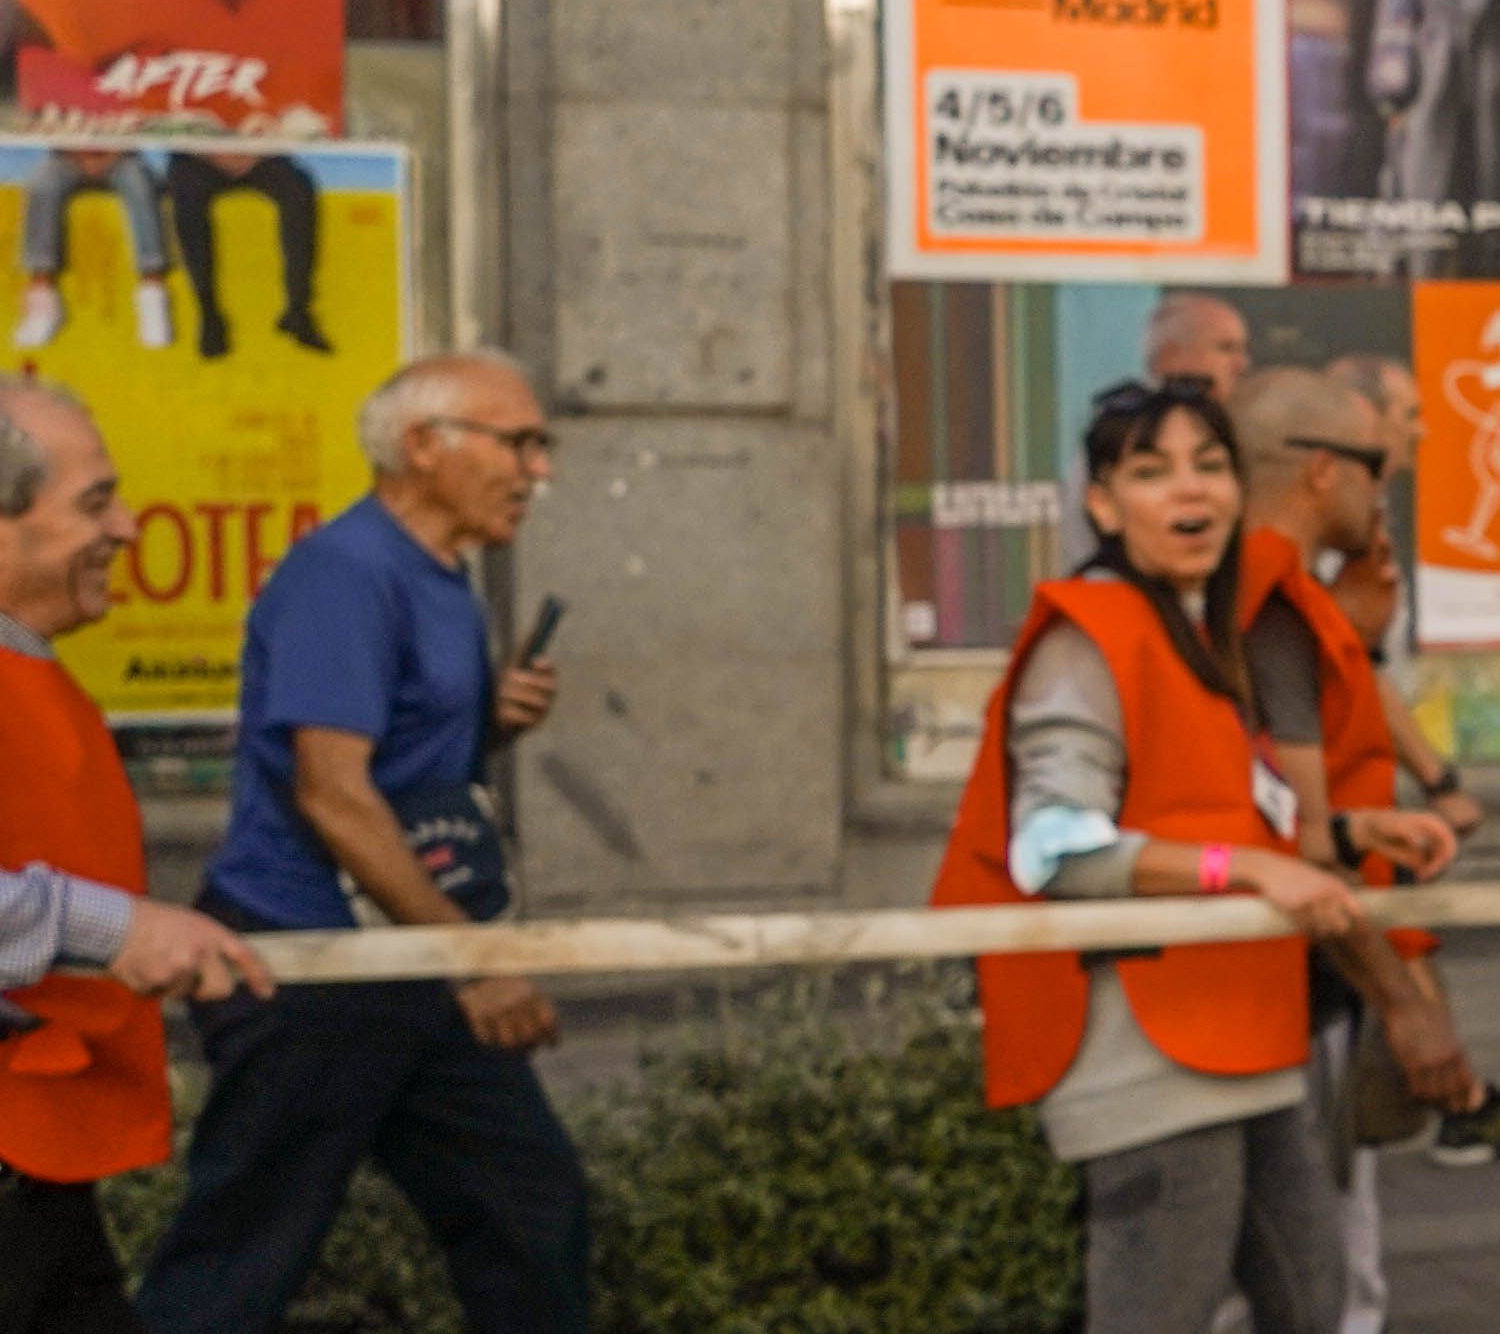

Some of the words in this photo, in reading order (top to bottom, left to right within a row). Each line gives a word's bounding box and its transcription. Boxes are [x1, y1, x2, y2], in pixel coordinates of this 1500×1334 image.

[93, 50, 269, 109] AFTER
[933, 88, 1068, 128] 4/5/6
[933, 132, 1187, 169] Noviembre
